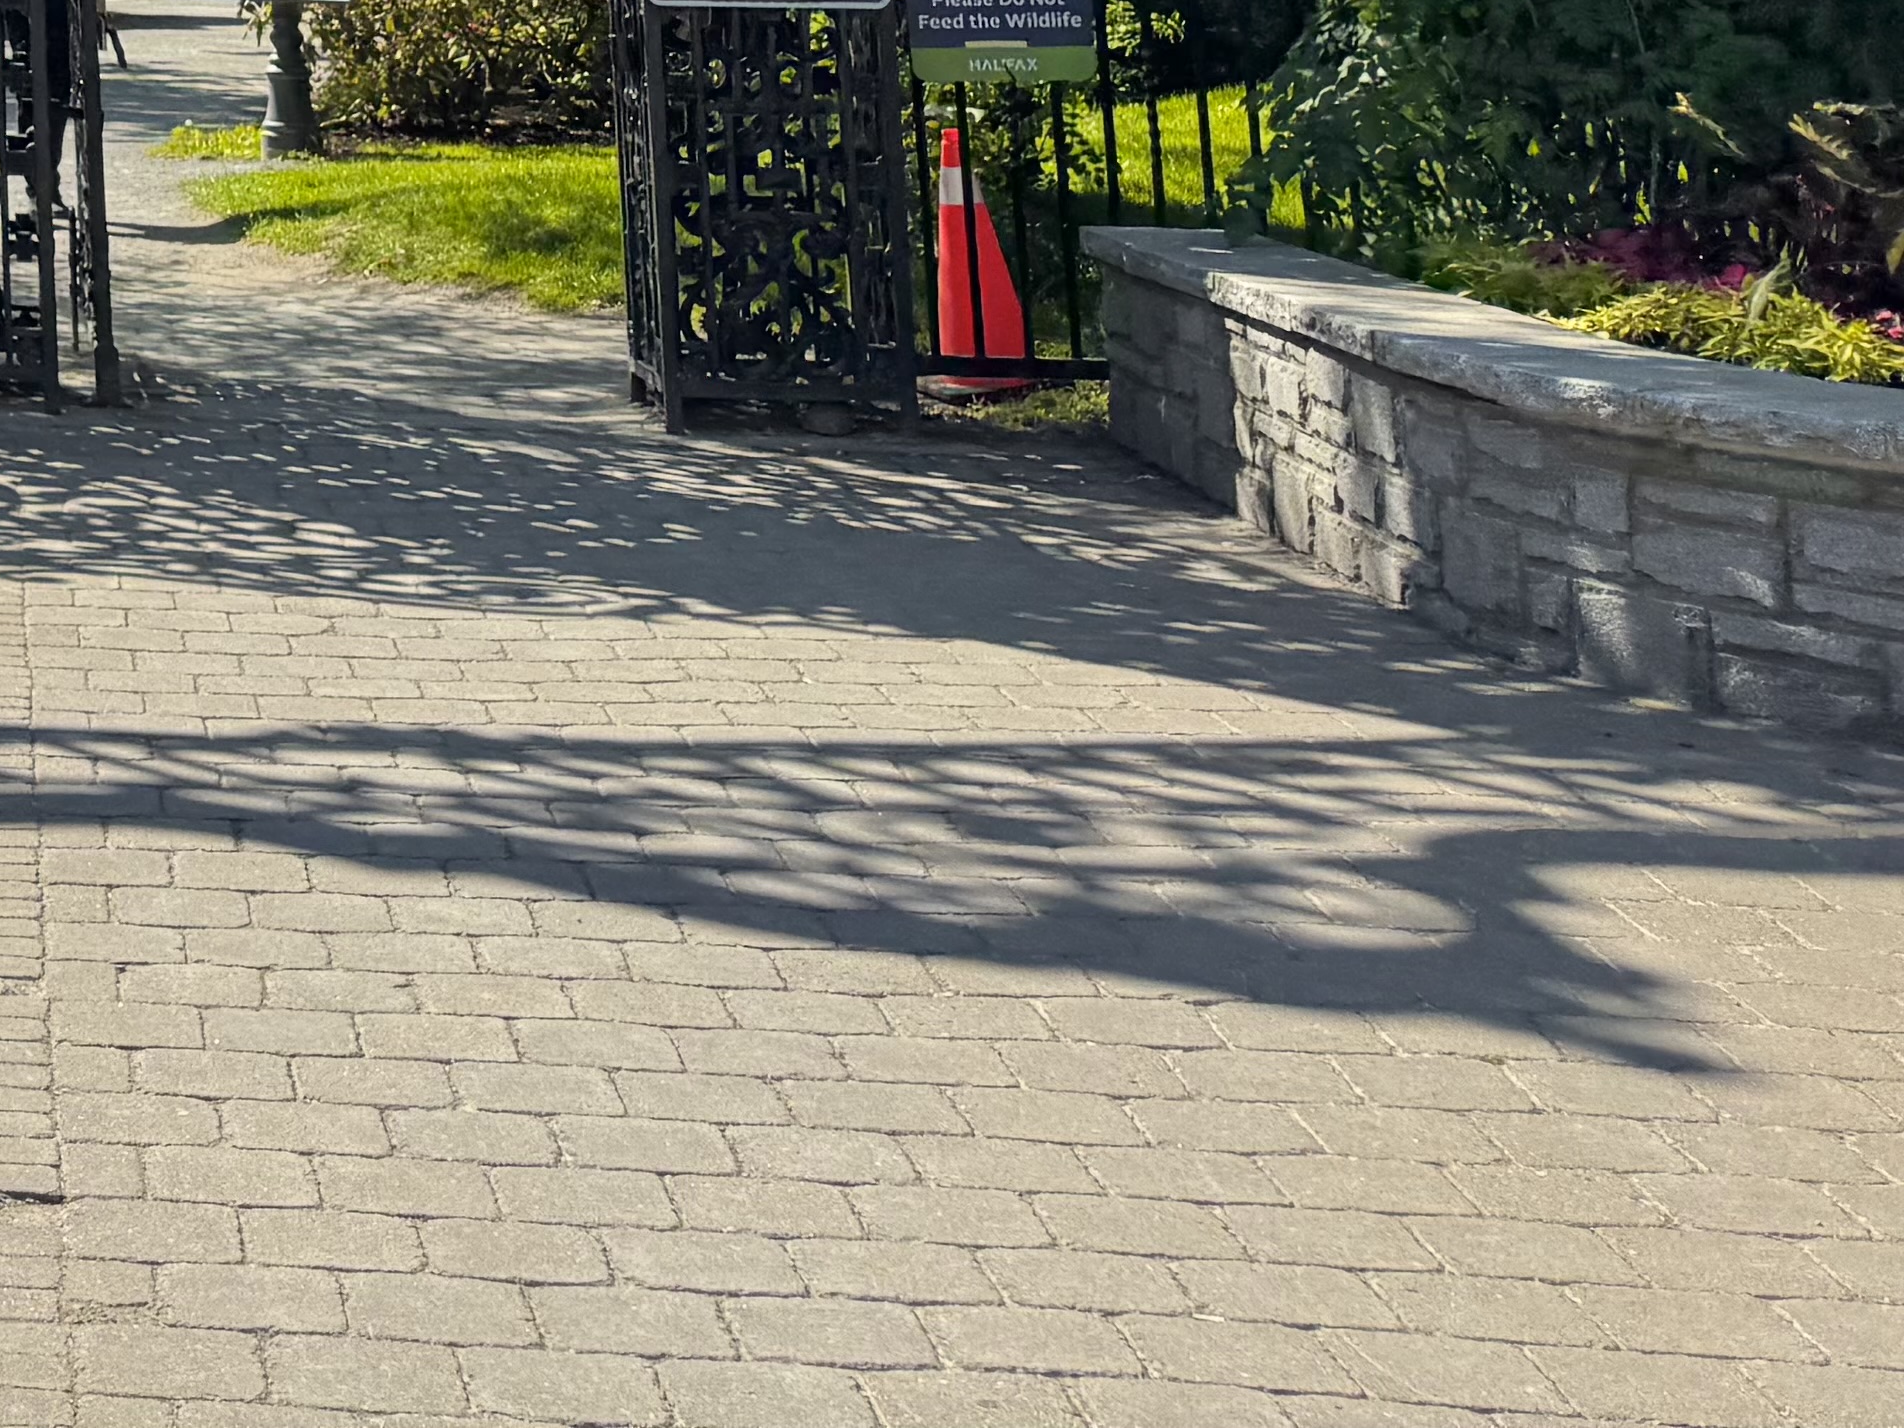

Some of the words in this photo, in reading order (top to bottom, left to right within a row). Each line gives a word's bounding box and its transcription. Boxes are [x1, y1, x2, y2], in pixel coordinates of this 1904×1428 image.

[918, 13, 964, 29] Feed
[970, 13, 1000, 29] the
[1005, 11, 1083, 29] Wildlife
[969, 58, 1038, 72] HALIFAX
